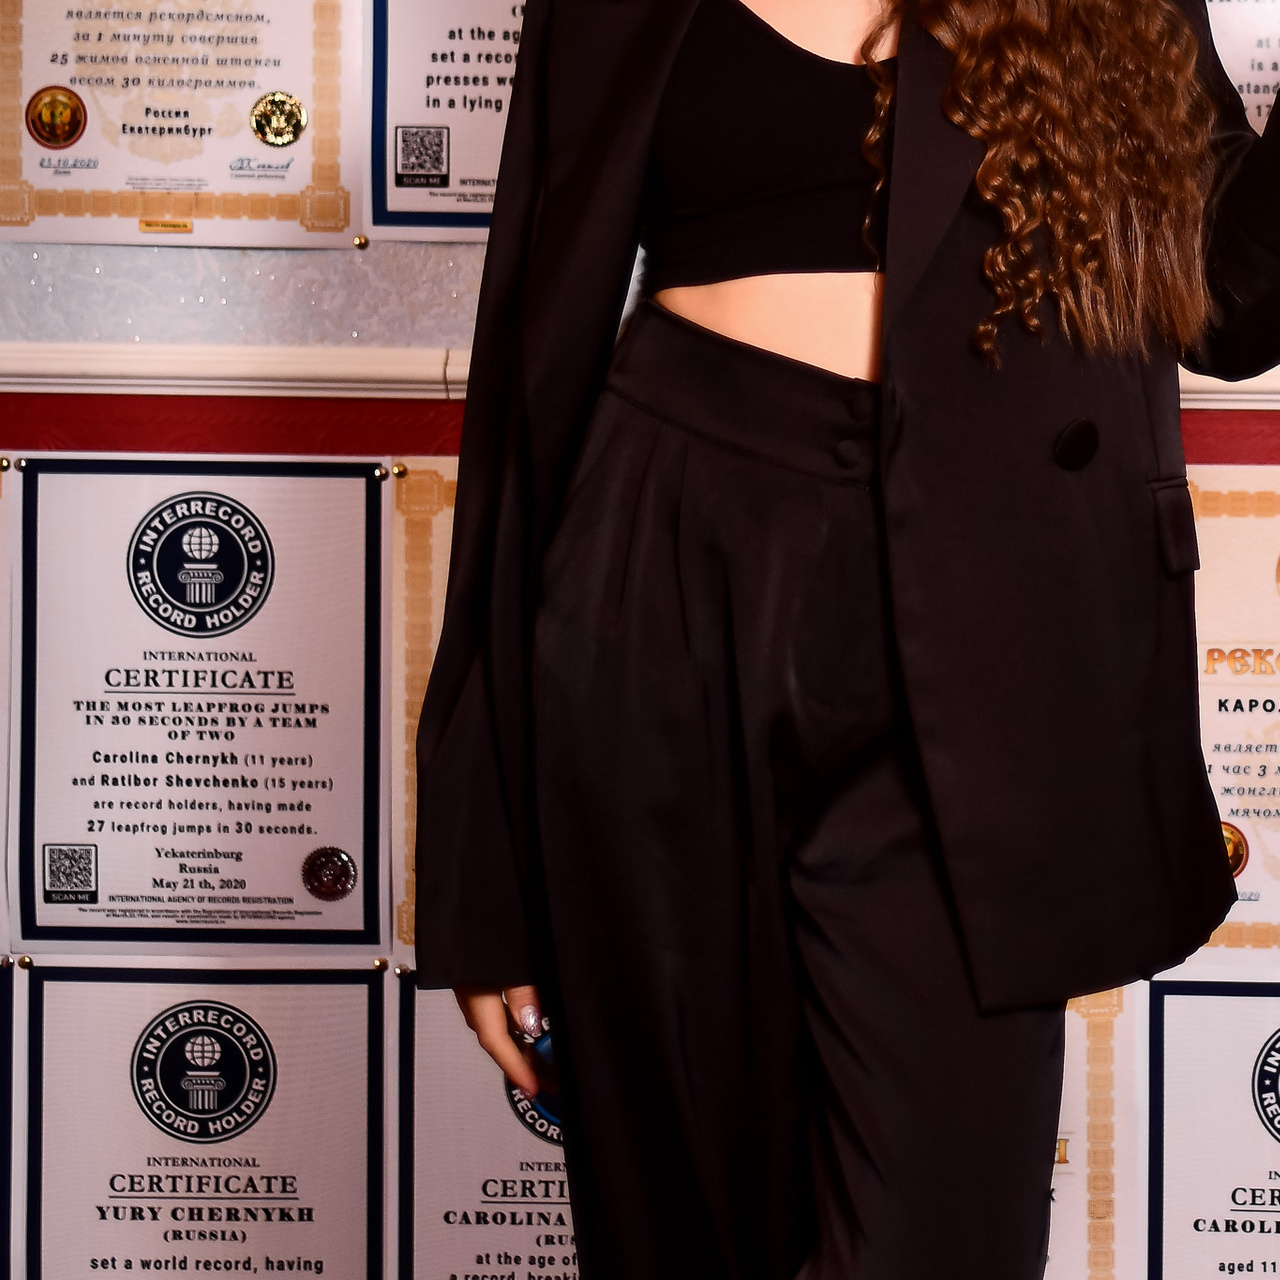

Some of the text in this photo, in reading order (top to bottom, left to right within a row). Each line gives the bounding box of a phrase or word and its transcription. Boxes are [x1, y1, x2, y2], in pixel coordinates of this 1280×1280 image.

[104, 668, 295, 689] CERTIFICATE
[72, 700, 330, 715] THE MOST LEAPFROG JUMPS
[87, 819, 318, 836] 27 leapfrog jumps in 30 seconds.
[108, 1173, 298, 1194] CERTIFICATE
[95, 1205, 315, 1222] YURY CHERNYKH
[443, 1210, 567, 1226] CAROLINA
